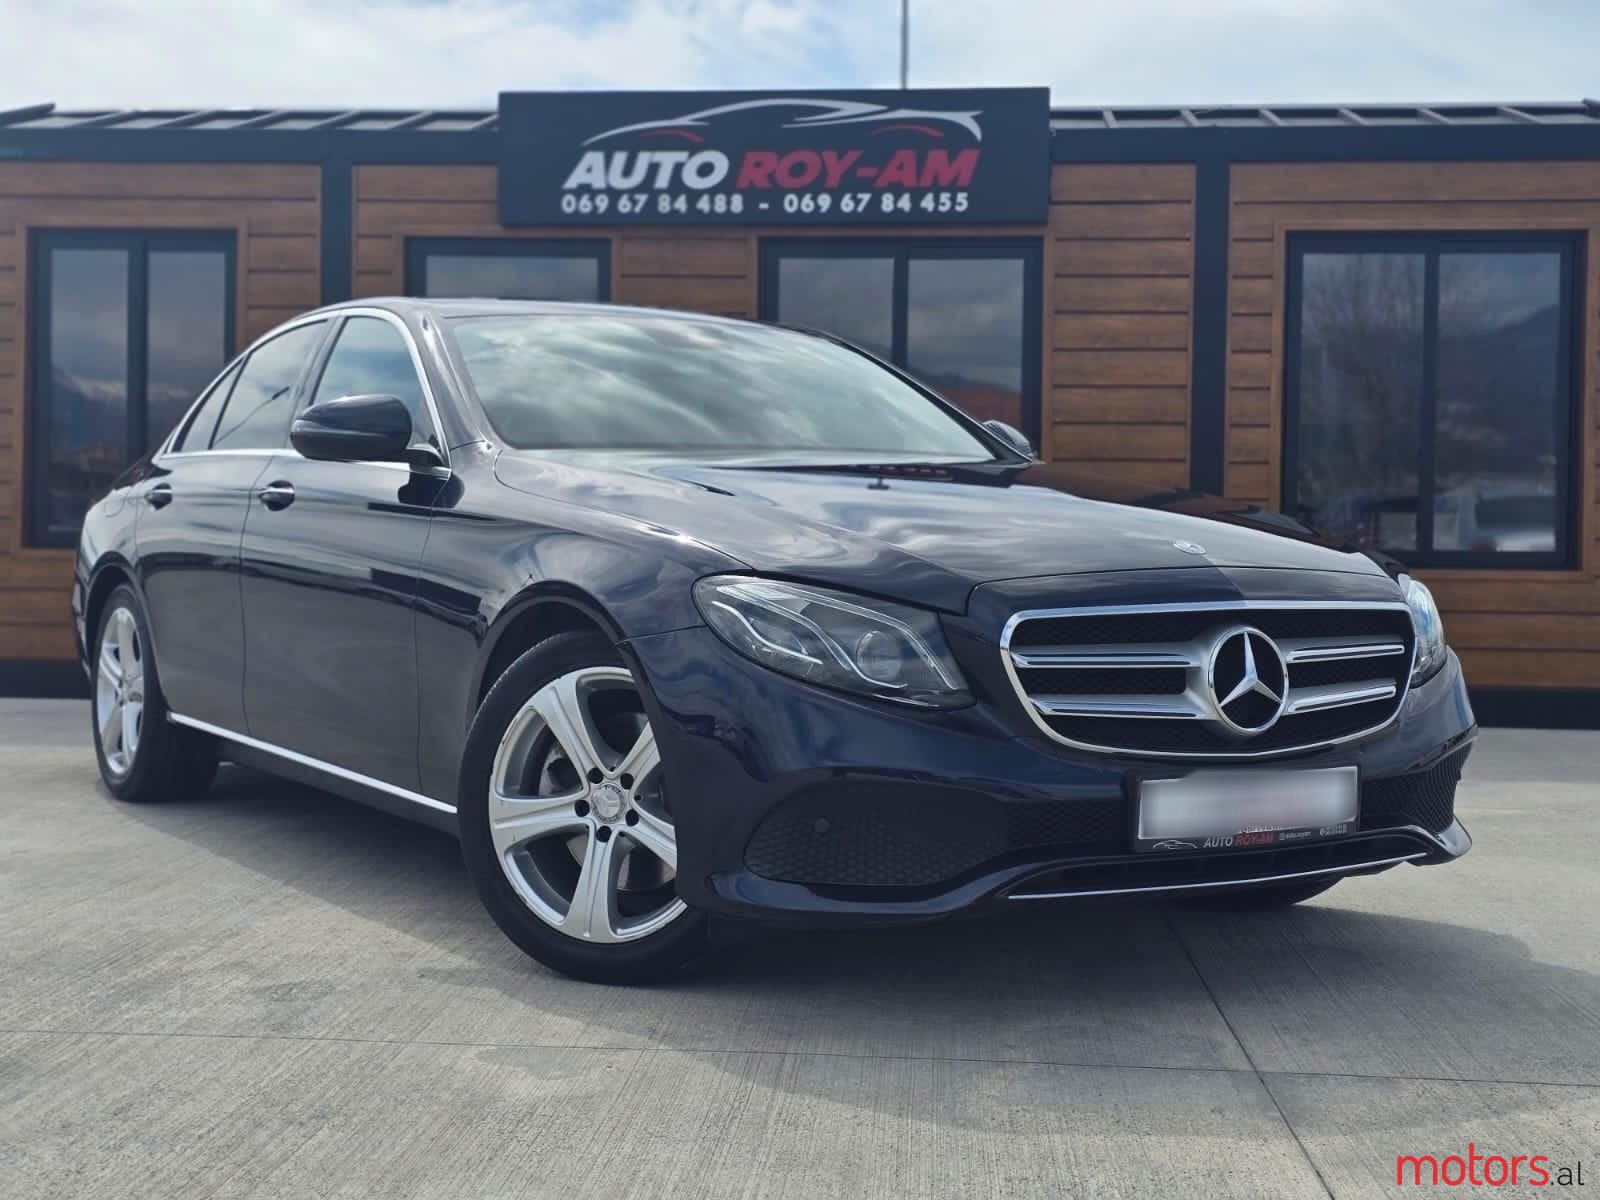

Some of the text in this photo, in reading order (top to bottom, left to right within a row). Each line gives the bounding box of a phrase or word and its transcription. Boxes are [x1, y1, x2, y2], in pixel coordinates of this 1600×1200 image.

[562, 148, 981, 190] AUTO ROY-AM
[561, 194, 609, 214] 069
[618, 194, 648, 213] 67
[657, 194, 687, 213] 84
[696, 193, 745, 213] 488
[783, 193, 832, 213] 069
[840, 193, 872, 212] 67
[881, 192, 912, 212] 84
[920, 192, 969, 212] 455
[1203, 836, 1233, 849] AUTO
